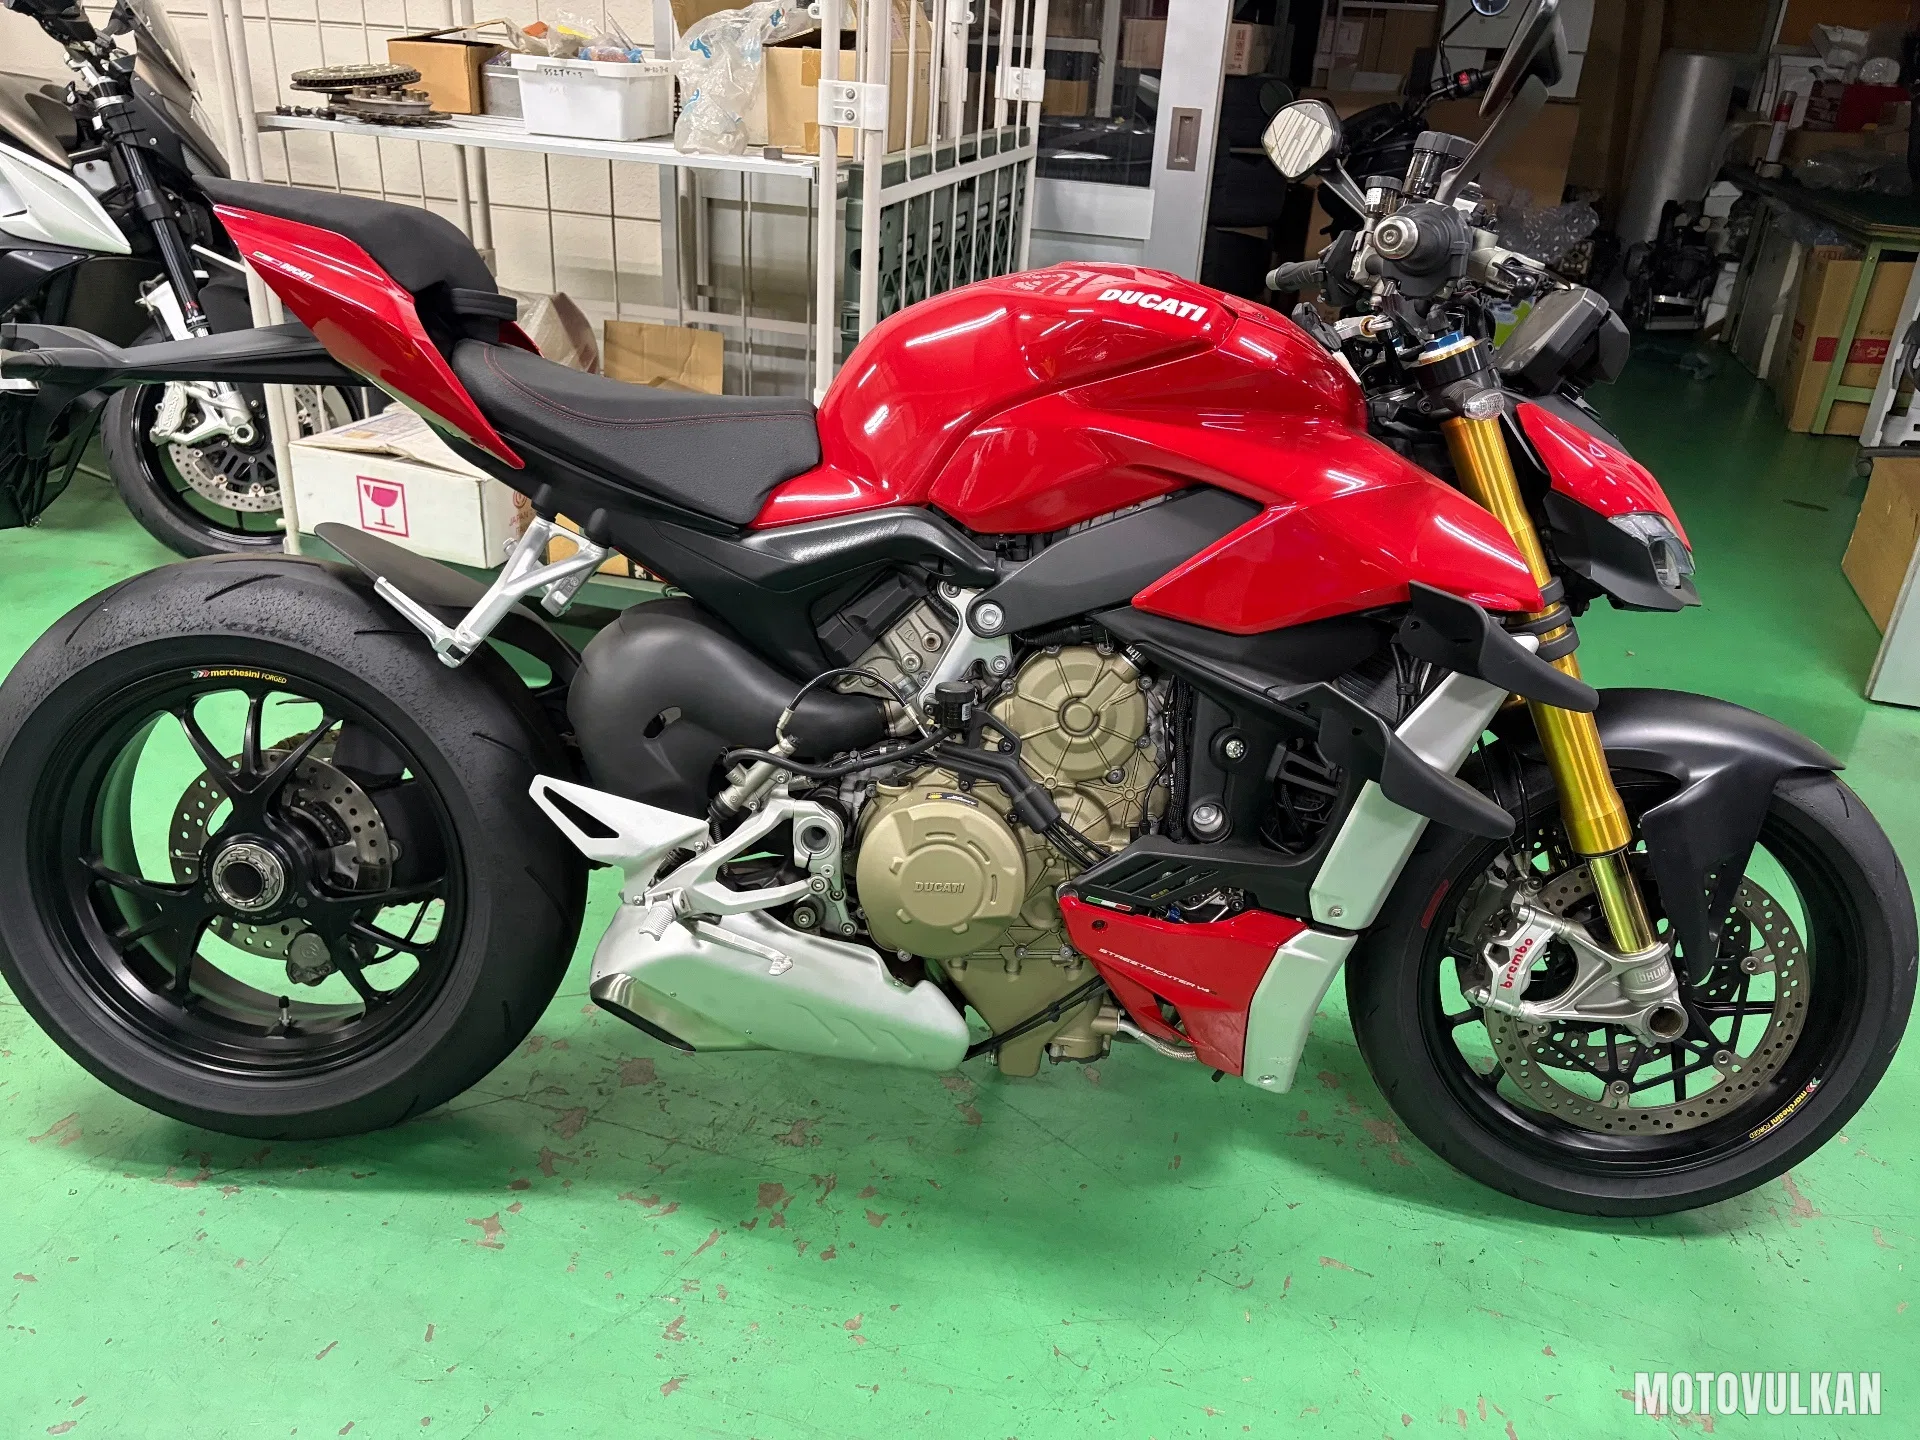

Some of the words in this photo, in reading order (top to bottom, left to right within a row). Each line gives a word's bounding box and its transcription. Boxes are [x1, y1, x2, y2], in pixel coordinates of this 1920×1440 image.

[280, 262, 315, 281] DUCATI
[1097, 288, 1208, 322] DUCATI
[210, 668, 260, 679] marchesini
[261, 672, 287, 684] FORGED
[914, 881, 966, 894] DUCATI
[1098, 947, 1196, 988] STREETFIGHTER
[1500, 938, 1533, 989] brembo
[1770, 1090, 1808, 1125] marchesini
[1749, 1122, 1771, 1139] FORGED
